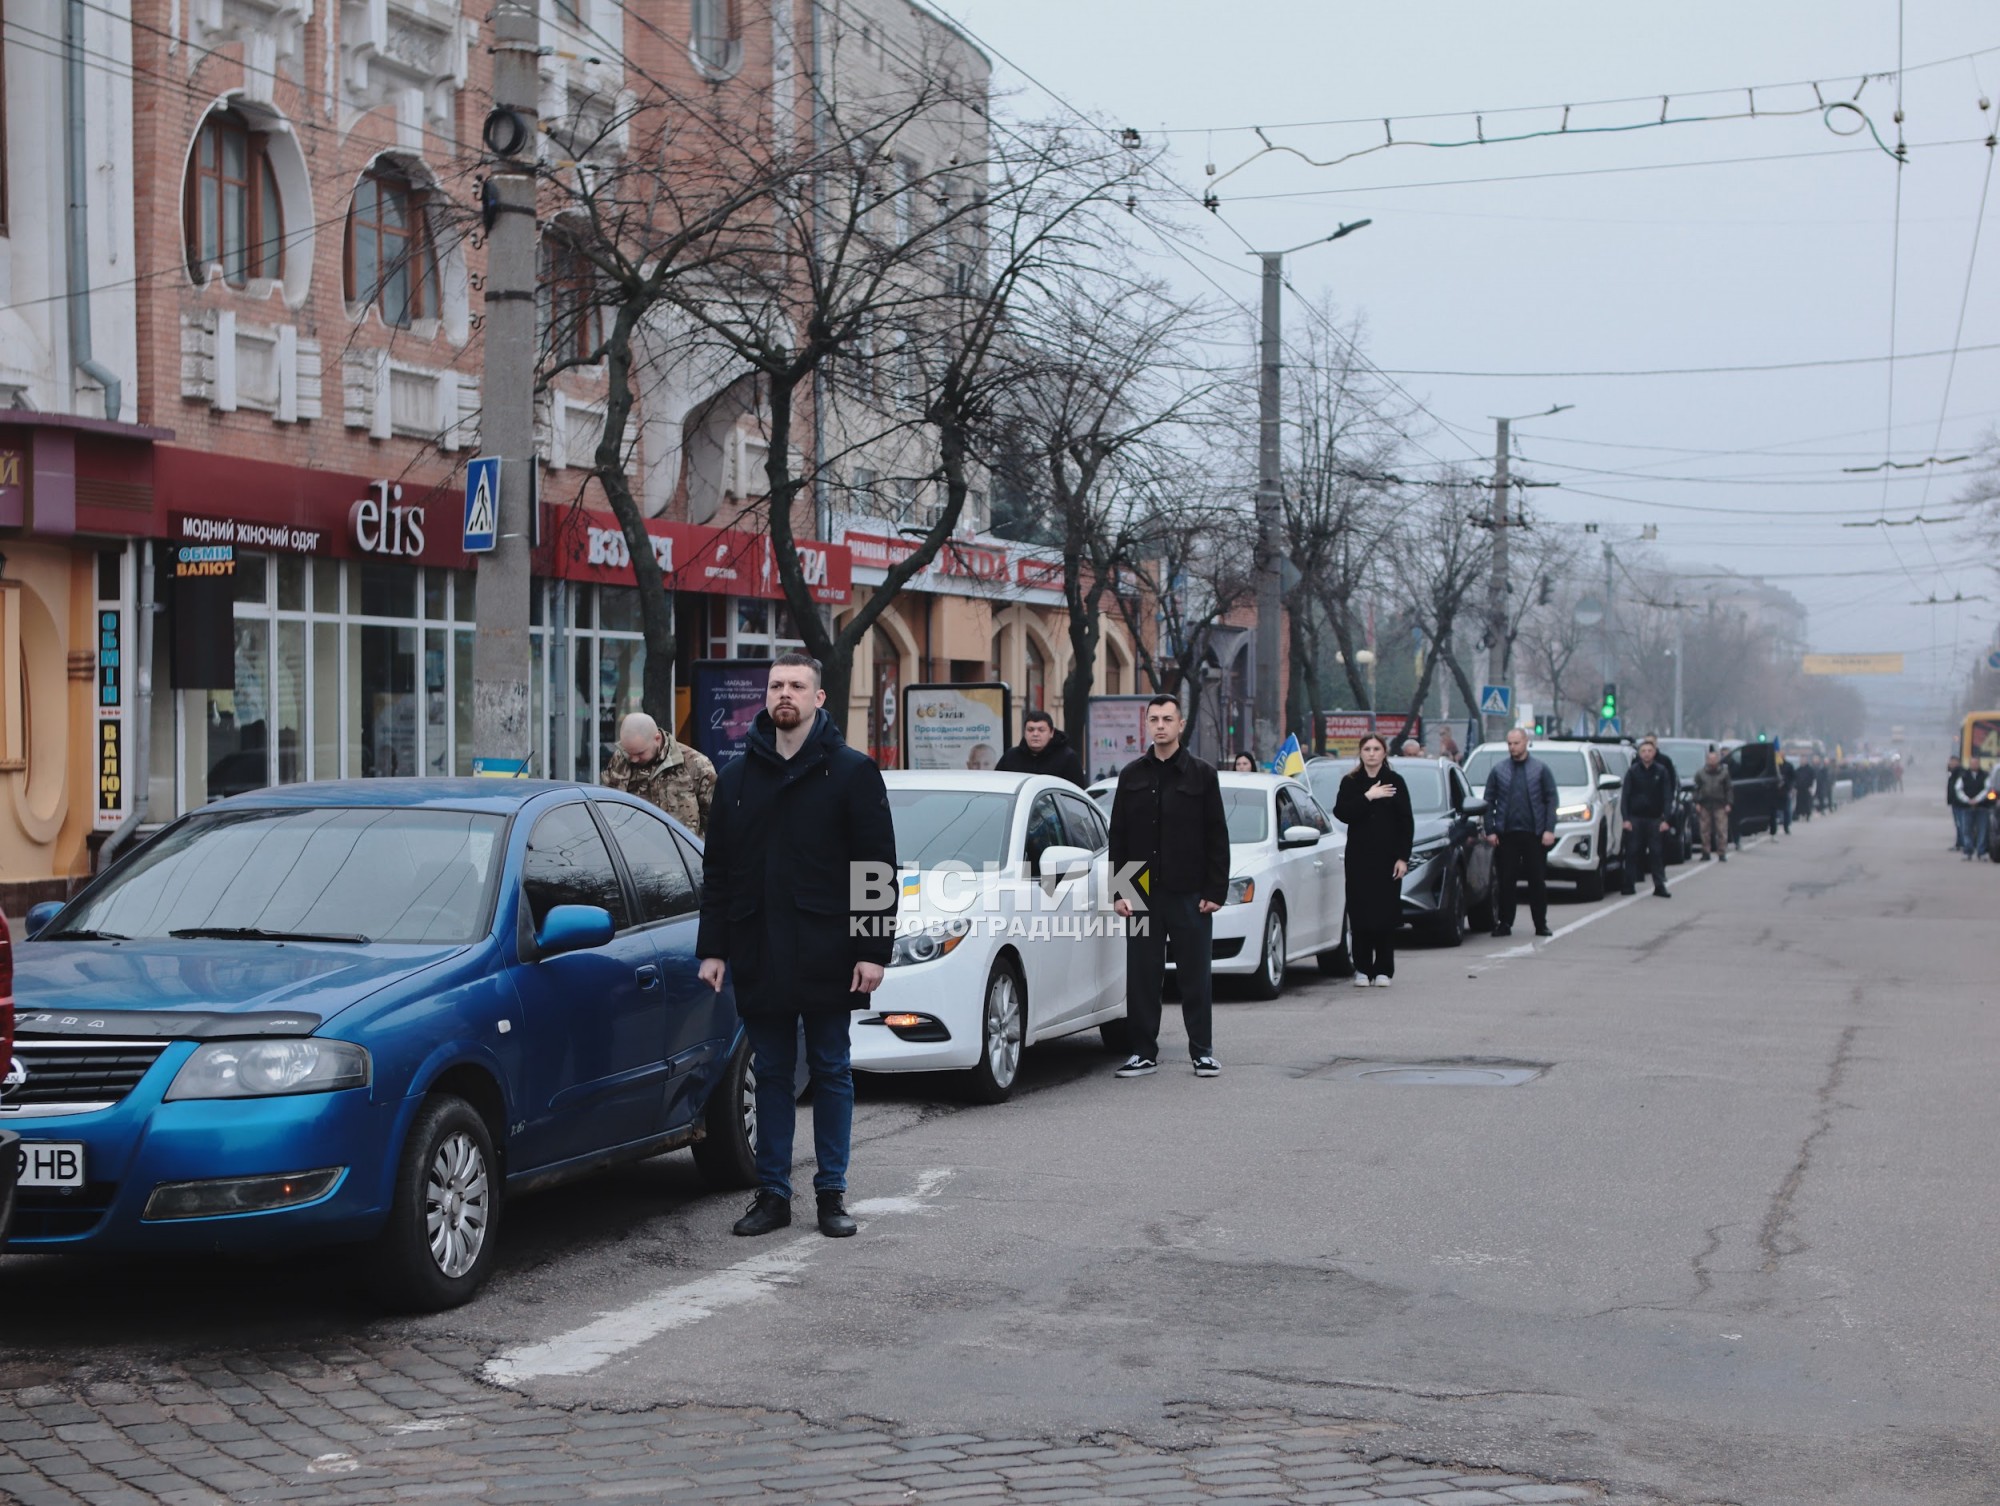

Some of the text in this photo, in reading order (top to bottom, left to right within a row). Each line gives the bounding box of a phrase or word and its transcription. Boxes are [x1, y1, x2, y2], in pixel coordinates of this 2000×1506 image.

[182, 516, 320, 552] МОДНИЙ ЖІНОЧИЙ ОДЯГ
[354, 479, 425, 557] elis
[176, 560, 236, 577] ВАЛЮТ
[178, 545, 233, 563] ОБМІН
[101, 612, 119, 704] ОБМІН
[914, 724, 991, 734] Проводимо набір
[101, 724, 120, 809] ВАЛЮТ
[34, 1149, 78, 1180] HB
